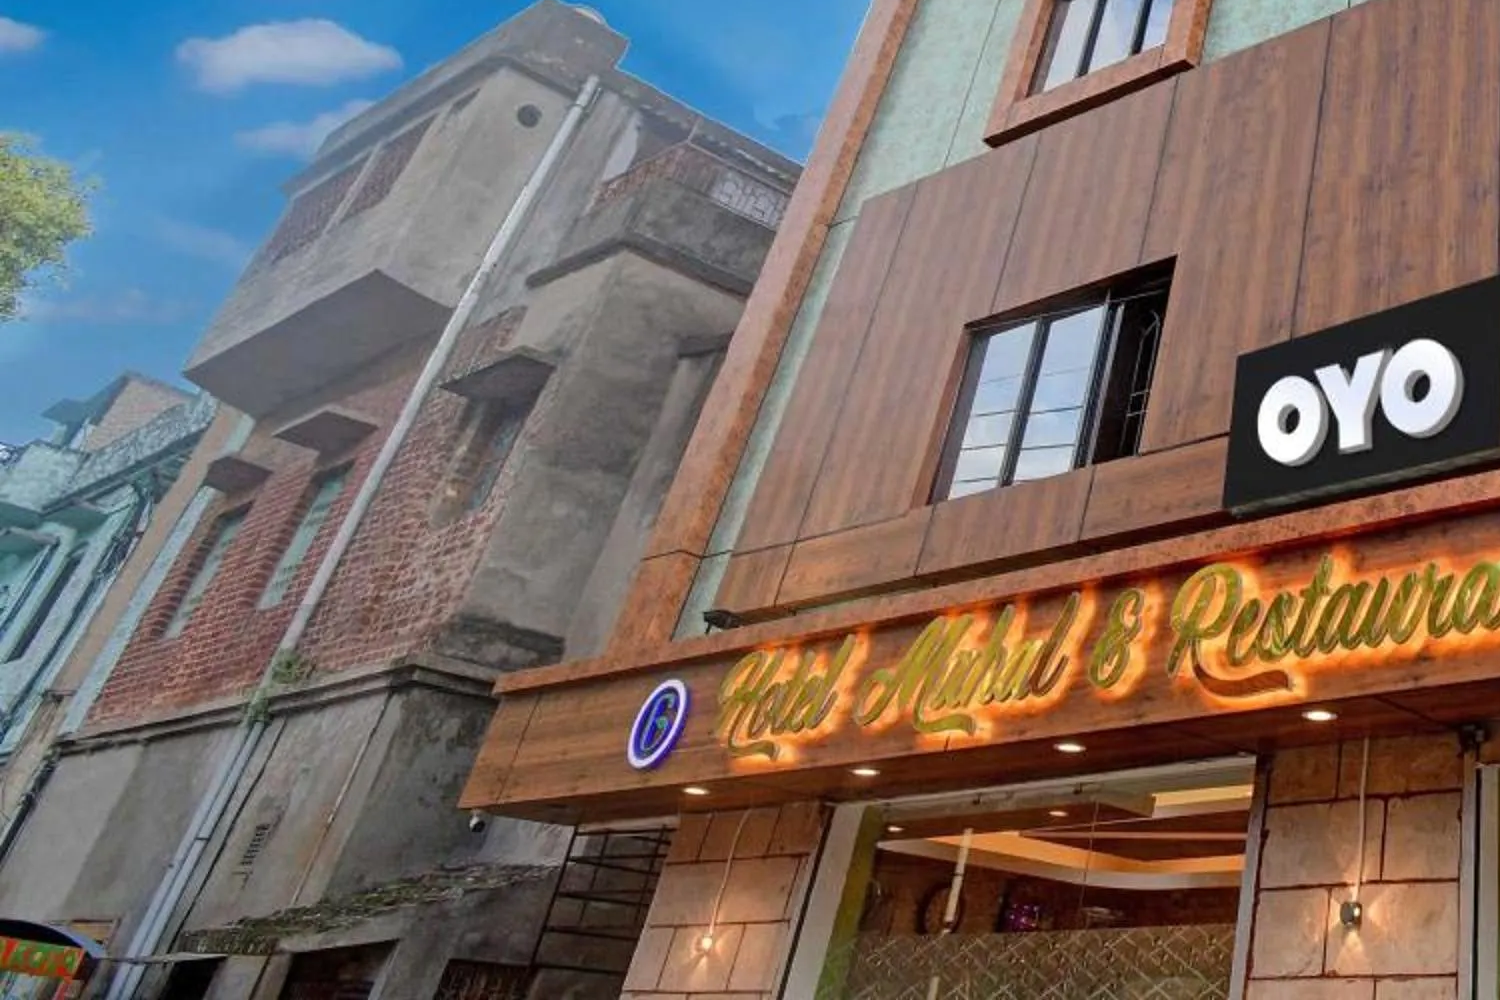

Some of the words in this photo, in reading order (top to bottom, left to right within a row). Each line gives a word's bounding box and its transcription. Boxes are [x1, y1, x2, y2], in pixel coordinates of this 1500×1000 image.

[1257, 338, 1464, 467] OYO
[718, 633, 857, 761] Hotel
[1087, 588, 1145, 690] &
